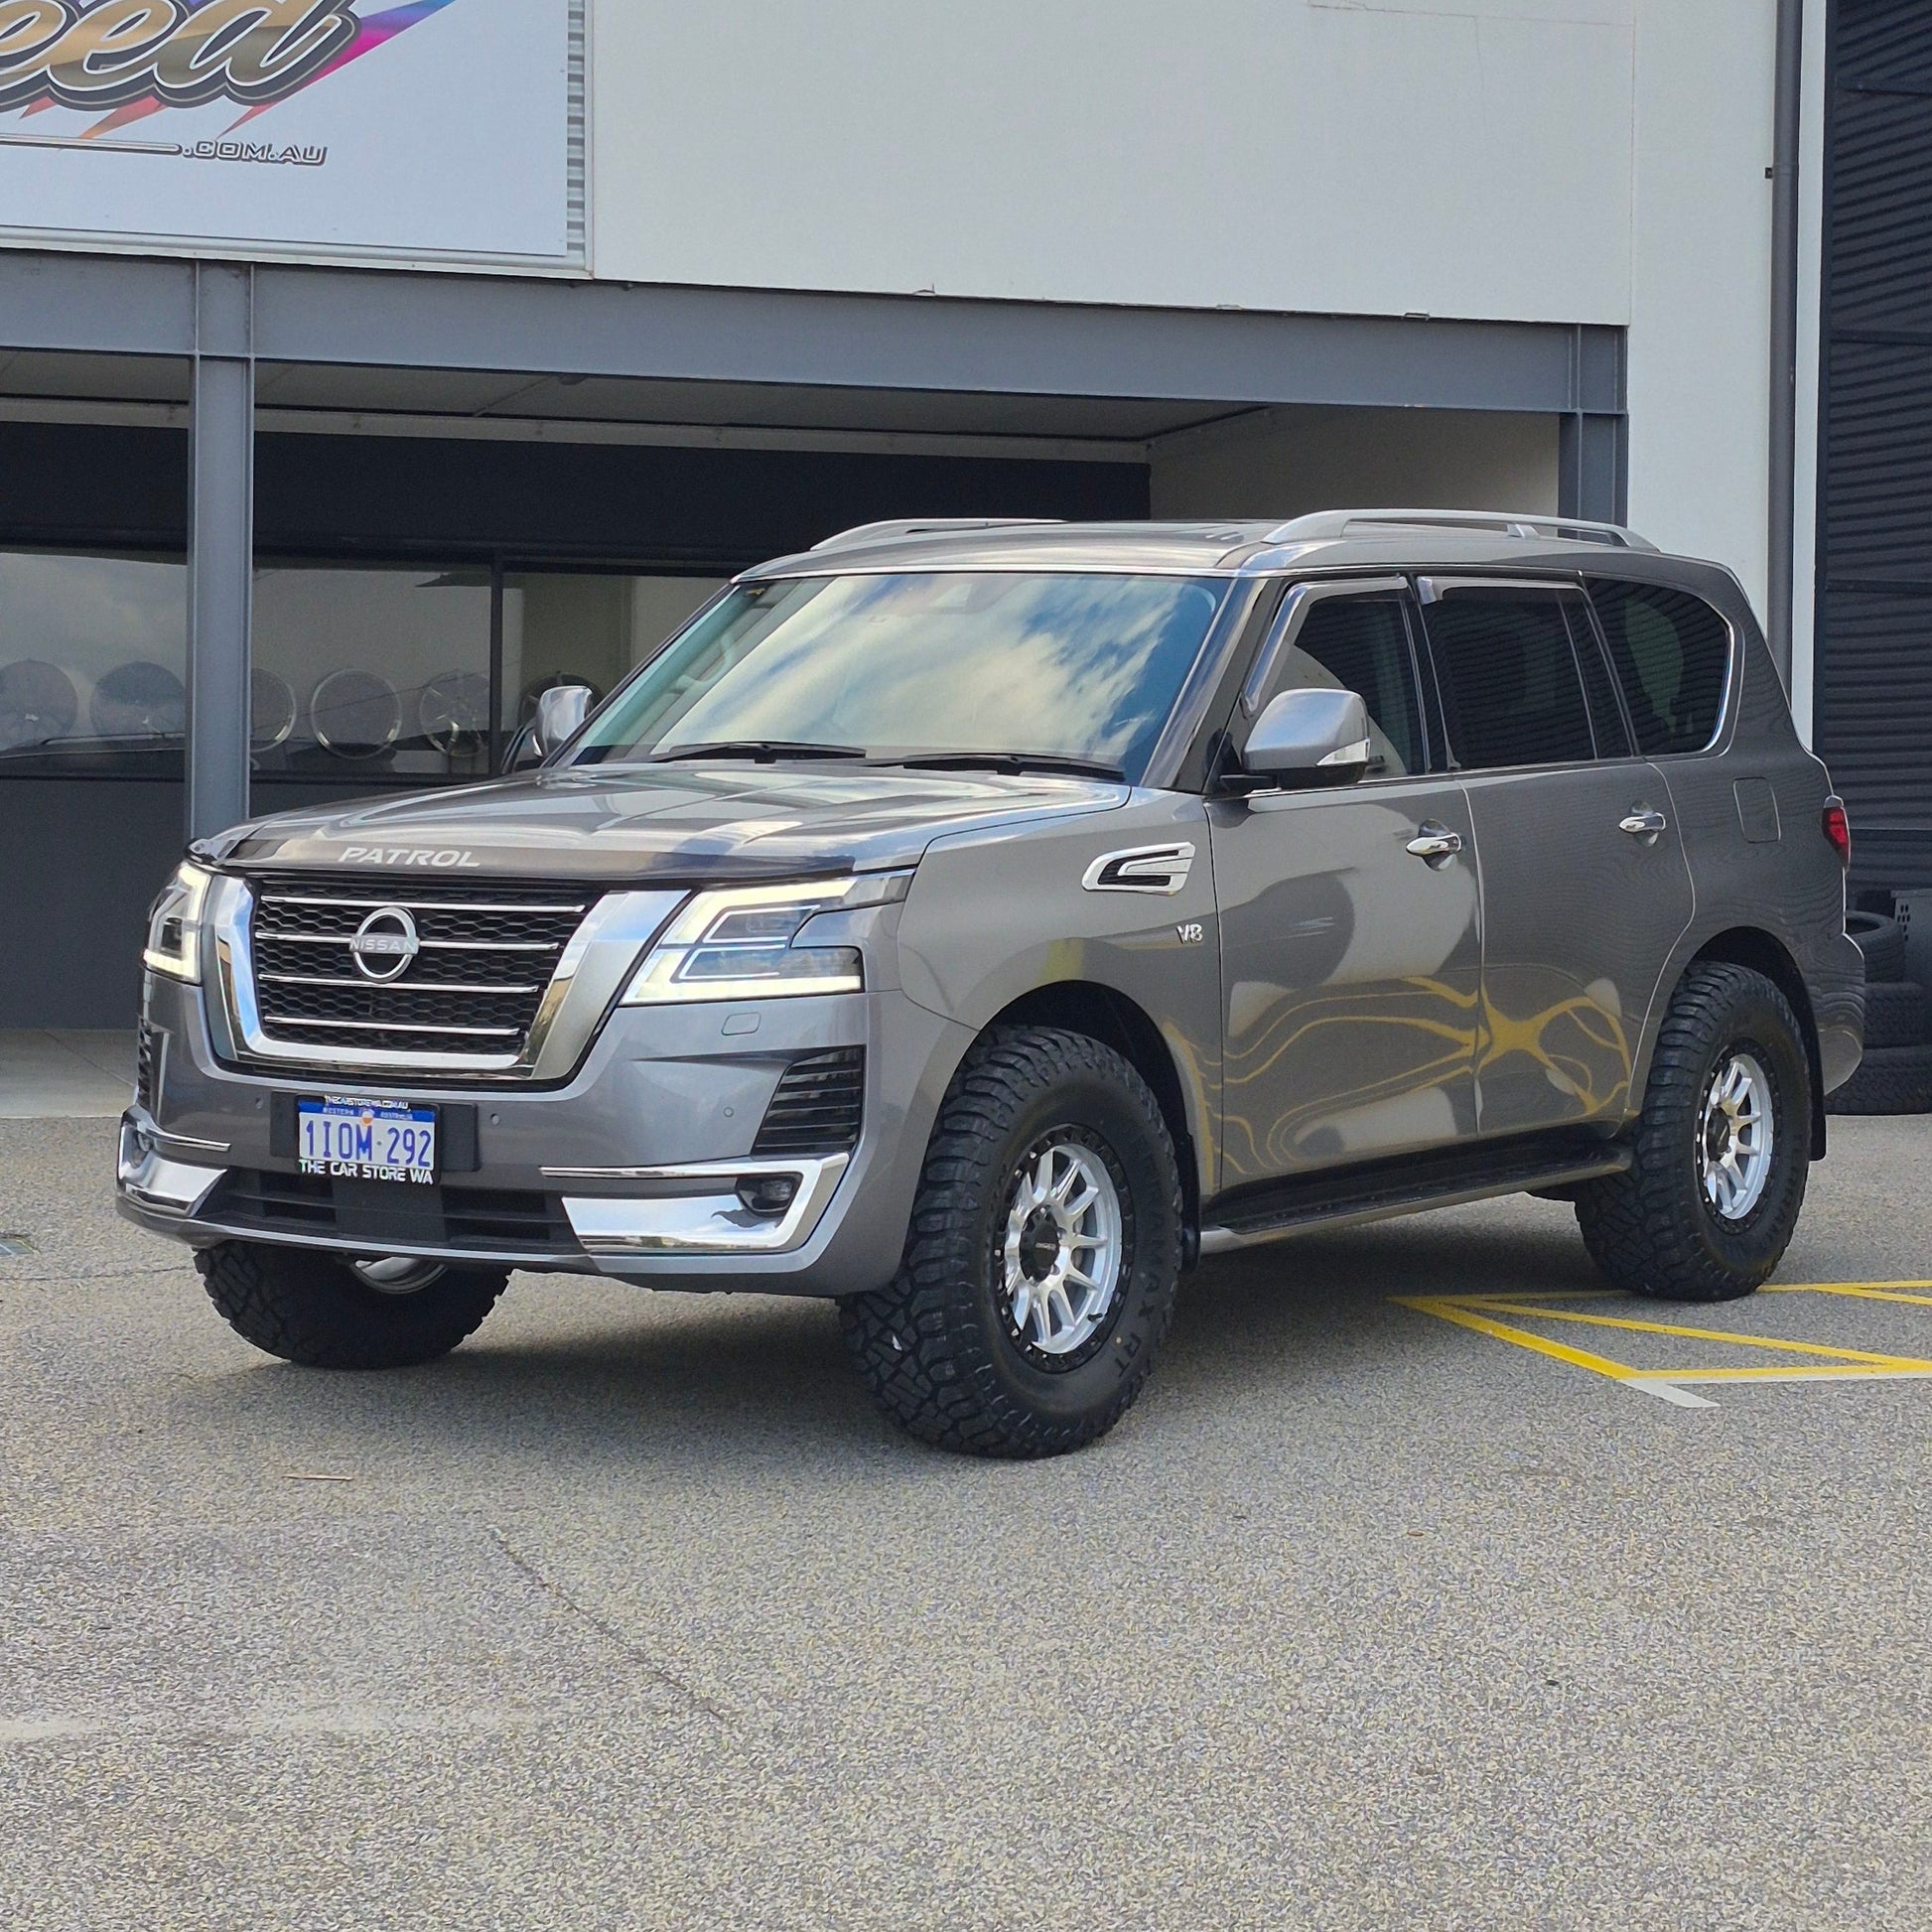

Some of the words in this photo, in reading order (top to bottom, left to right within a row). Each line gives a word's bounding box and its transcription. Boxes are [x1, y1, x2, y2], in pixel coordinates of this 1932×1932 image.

[181, 140, 328, 166] .COM.AU
[338, 847, 482, 867] PATROL
[1176, 923, 1203, 943] V8
[349, 936, 417, 952] NISSAN
[299, 1160, 326, 1174] THE
[330, 1162, 357, 1177] CAR
[362, 1165, 406, 1182] STORE
[410, 1169, 434, 1185] WA
